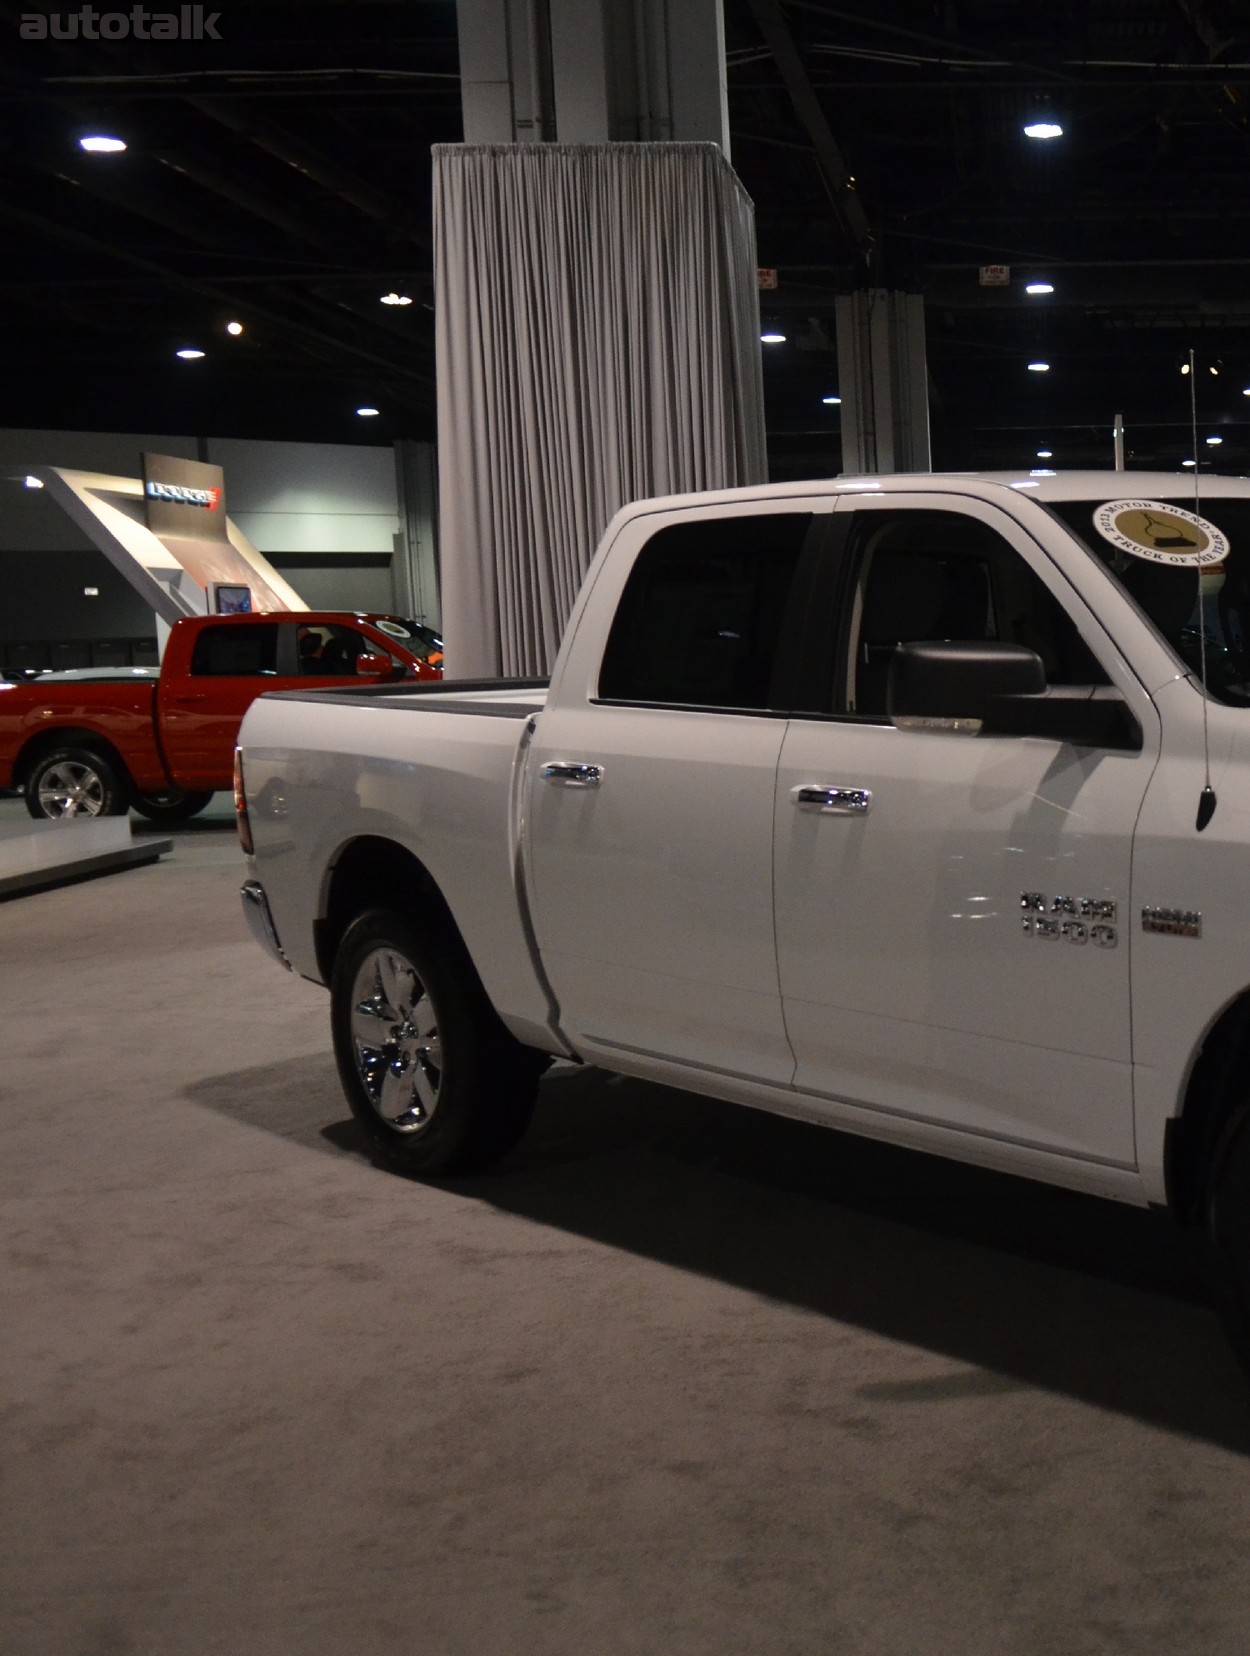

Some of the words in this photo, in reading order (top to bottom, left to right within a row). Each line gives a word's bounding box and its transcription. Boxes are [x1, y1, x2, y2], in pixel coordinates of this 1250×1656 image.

[1104, 502, 1153, 514] MOTOR
[1159, 505, 1210, 530] TREND
[1100, 513, 1115, 533] 2013
[1113, 535, 1164, 561] TRUCK
[1169, 556, 1188, 564] OF
[1191, 553, 1217, 564] THE
[1211, 533, 1226, 555] YEAR
[1020, 891, 1118, 924] RAM
[1021, 914, 1119, 950] 1500
